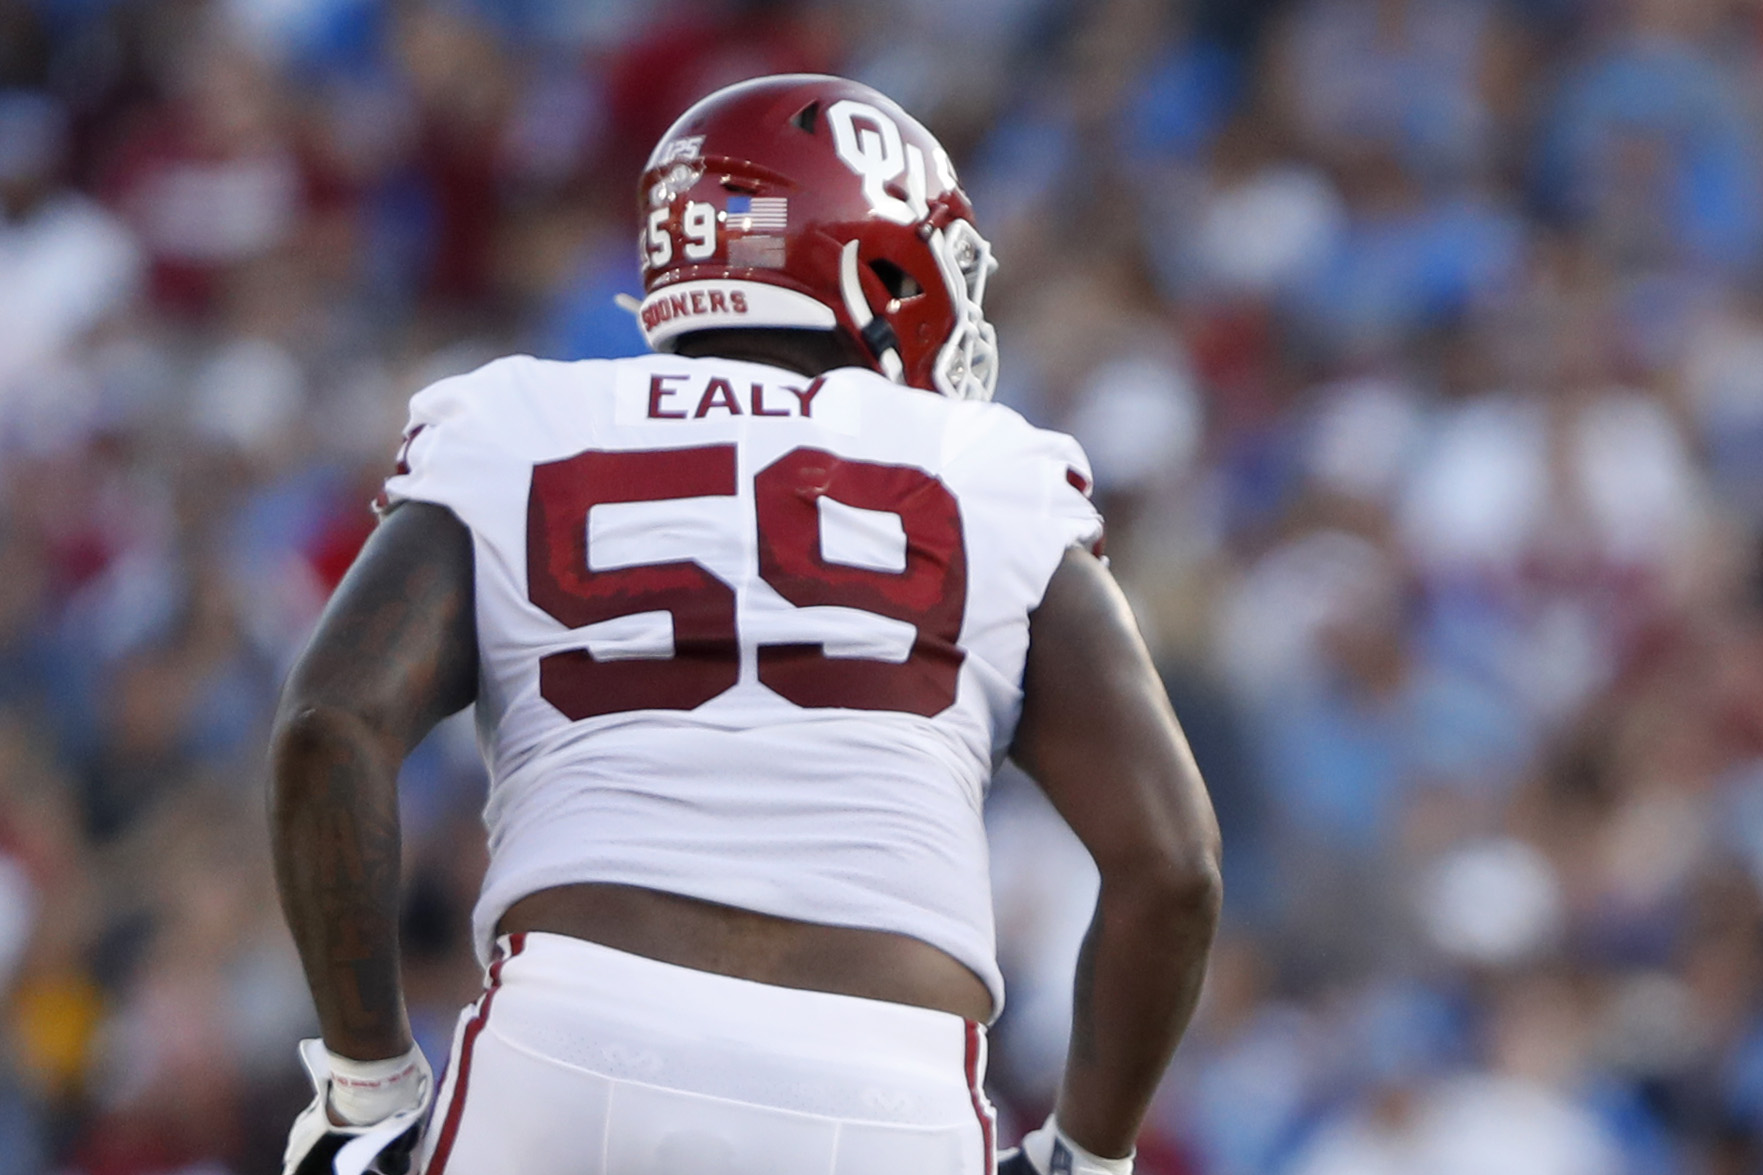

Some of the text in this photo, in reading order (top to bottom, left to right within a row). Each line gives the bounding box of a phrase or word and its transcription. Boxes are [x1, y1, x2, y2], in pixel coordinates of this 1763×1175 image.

[826, 100, 930, 226] OU
[650, 202, 717, 268] 59
[641, 289, 749, 332] SOONERS
[646, 374, 828, 419] EALY
[526, 443, 968, 722] 59
